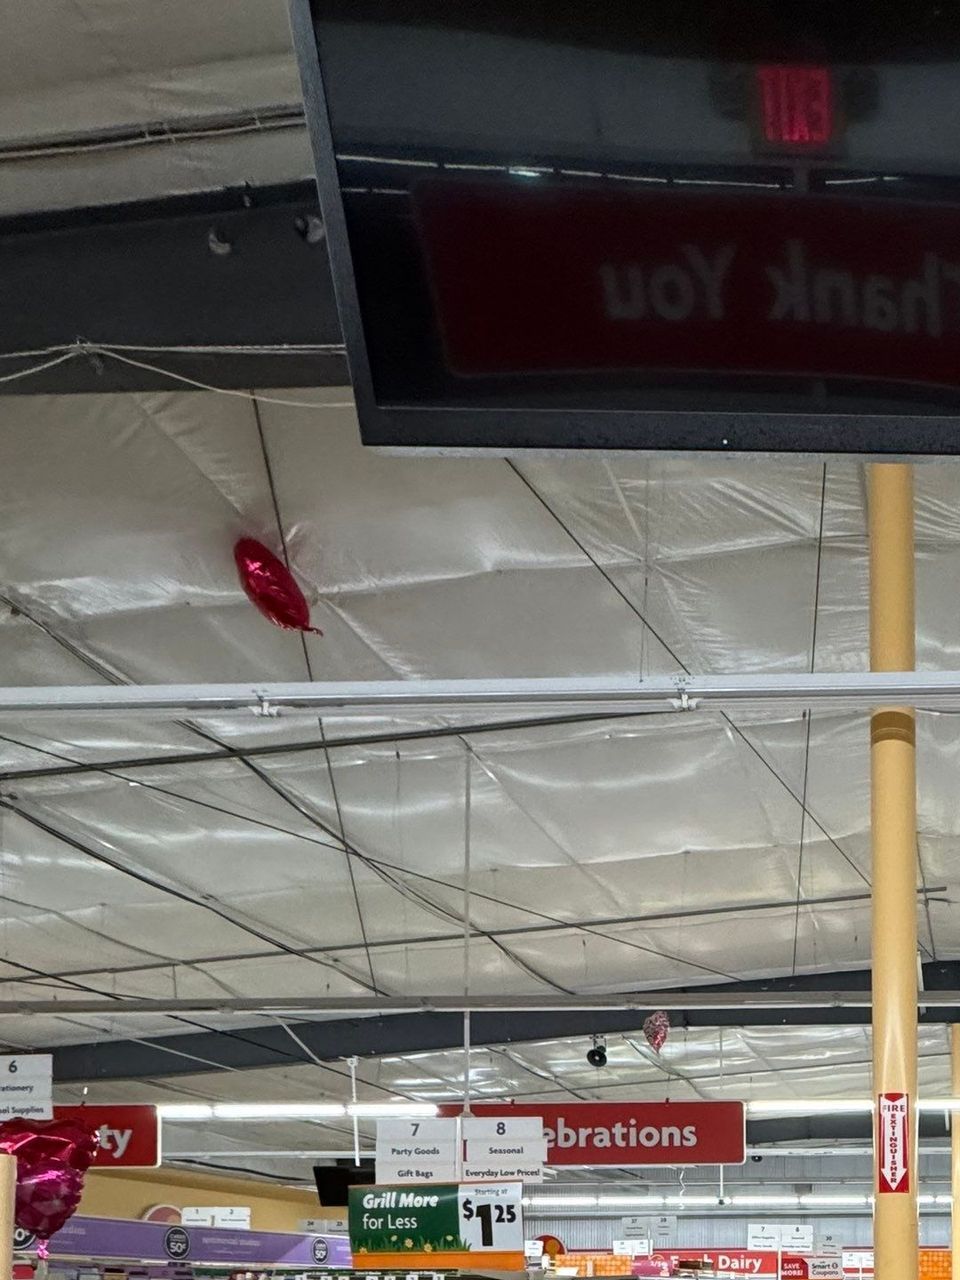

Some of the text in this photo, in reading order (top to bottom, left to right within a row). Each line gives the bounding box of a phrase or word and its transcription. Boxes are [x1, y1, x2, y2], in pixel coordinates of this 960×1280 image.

[8, 1060, 18, 1073] 6
[12, 1105, 44, 1114] Supplies
[411, 1123, 420, 1136] 7
[496, 1122, 506, 1135] 8
[542, 1118, 697, 1148] ebrations
[391, 1148, 412, 1156] Party
[489, 1146, 524, 1154] Seasonal
[889, 1114, 898, 1183] EXTINGUISHER
[397, 1169, 433, 1179] Gift Bags
[465, 1169, 498, 1179] Everyday
[517, 1169, 540, 1177] Prices!
[363, 1191, 439, 1209] Grill More
[362, 1213, 417, 1230] for Less
[169, 1242, 187, 1253] 50¢
[718, 1255, 762, 1273] Dairy
[811, 1262, 831, 1270] Smart
